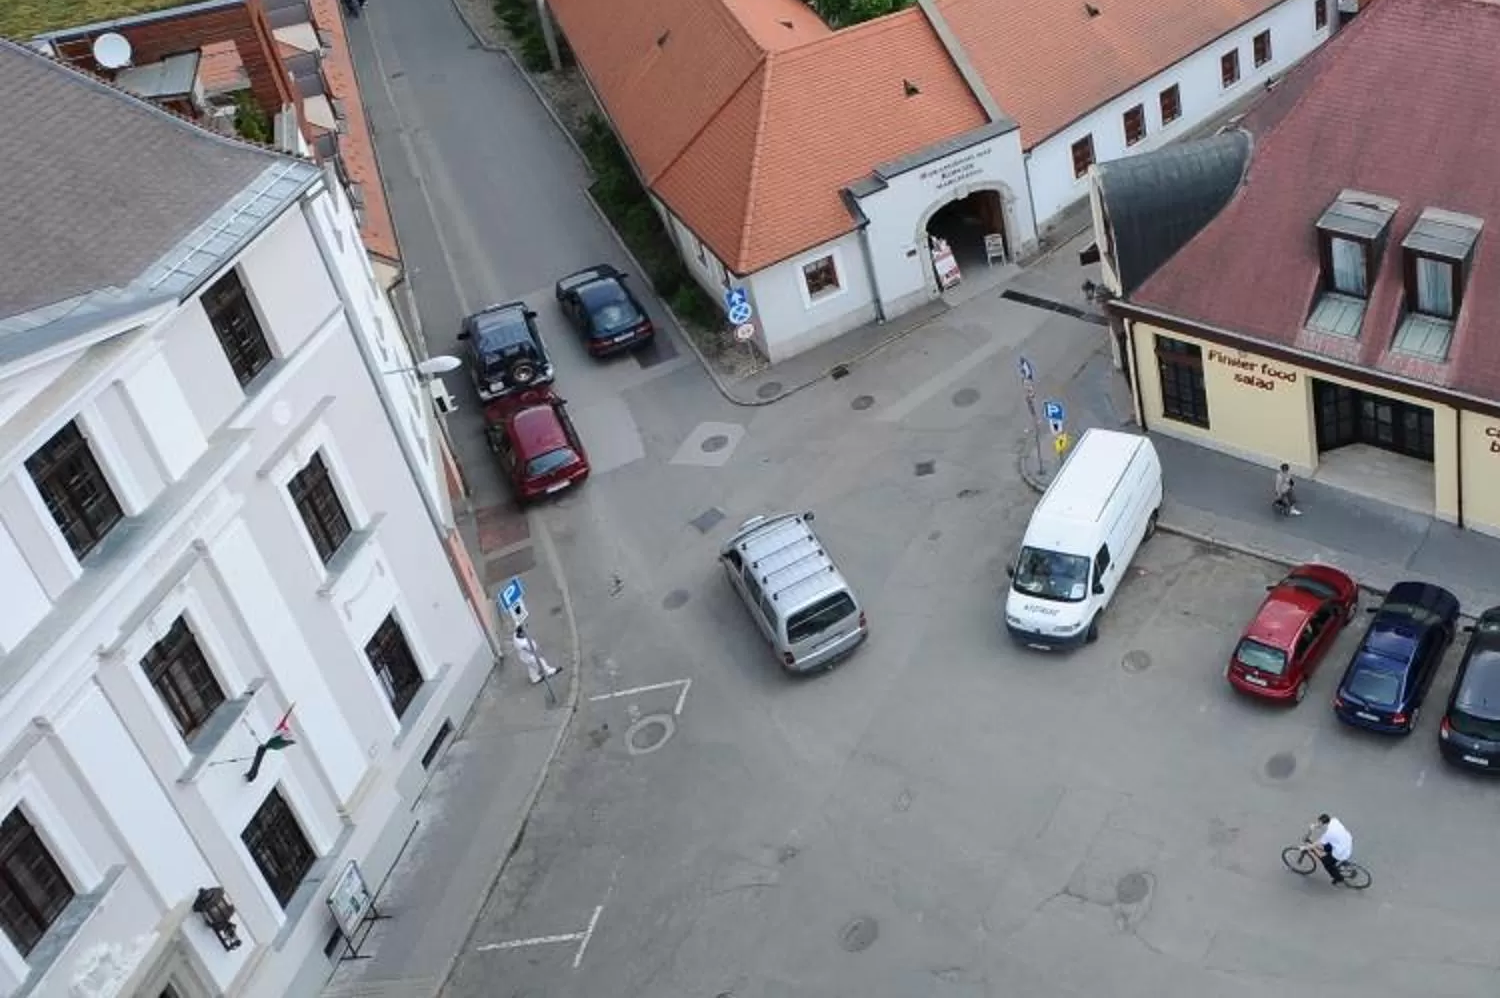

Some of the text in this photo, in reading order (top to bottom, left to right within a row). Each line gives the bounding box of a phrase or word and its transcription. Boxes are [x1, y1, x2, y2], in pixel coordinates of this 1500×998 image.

[1233, 373, 1274, 391] salad
[1261, 363, 1297, 383] food
[503, 584, 516, 605] P
